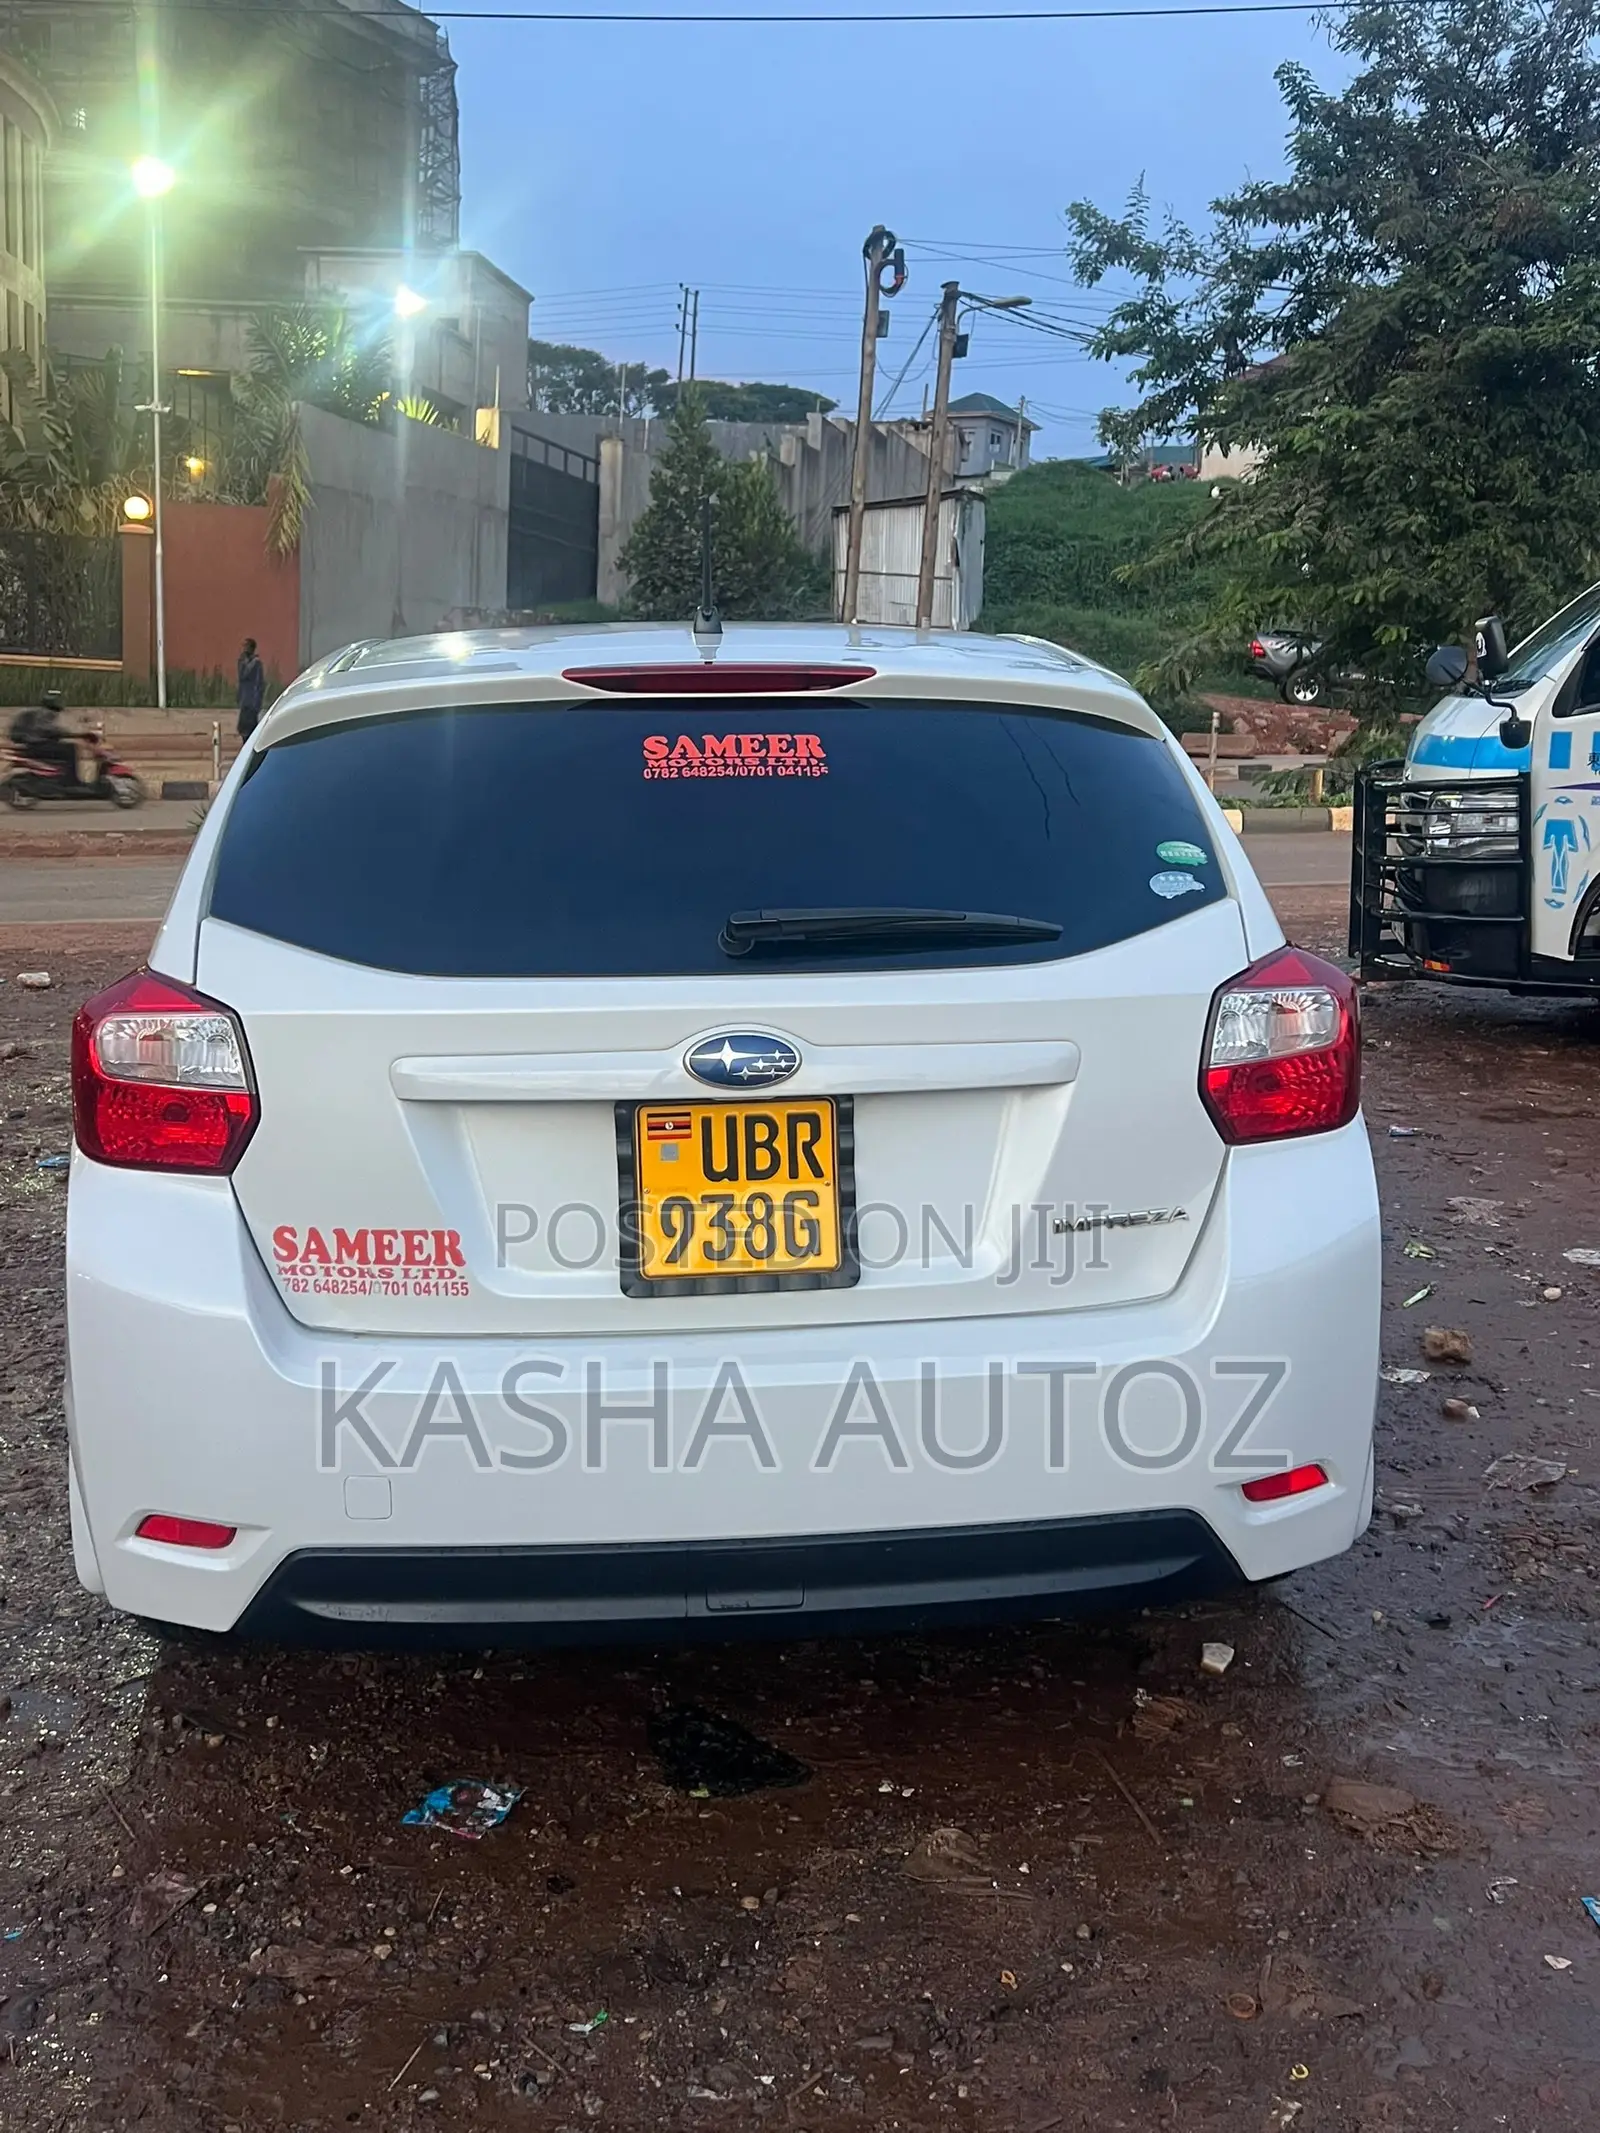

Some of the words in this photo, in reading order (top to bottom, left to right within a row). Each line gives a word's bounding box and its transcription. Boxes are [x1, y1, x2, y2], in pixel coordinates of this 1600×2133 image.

[642, 734, 827, 760] SAMEER
[643, 767, 679, 779] 0782
[682, 765, 773, 778] 648254/0701
[647, 757, 760, 768] MOTORS
[701, 1112, 825, 1183] UBR
[660, 1191, 821, 1264] 938G
[1052, 1205, 1190, 1235] IMPREZA
[272, 1225, 467, 1268] SAMEER
[276, 1264, 395, 1281] MOTORS
[413, 1280, 470, 1297] 041155
